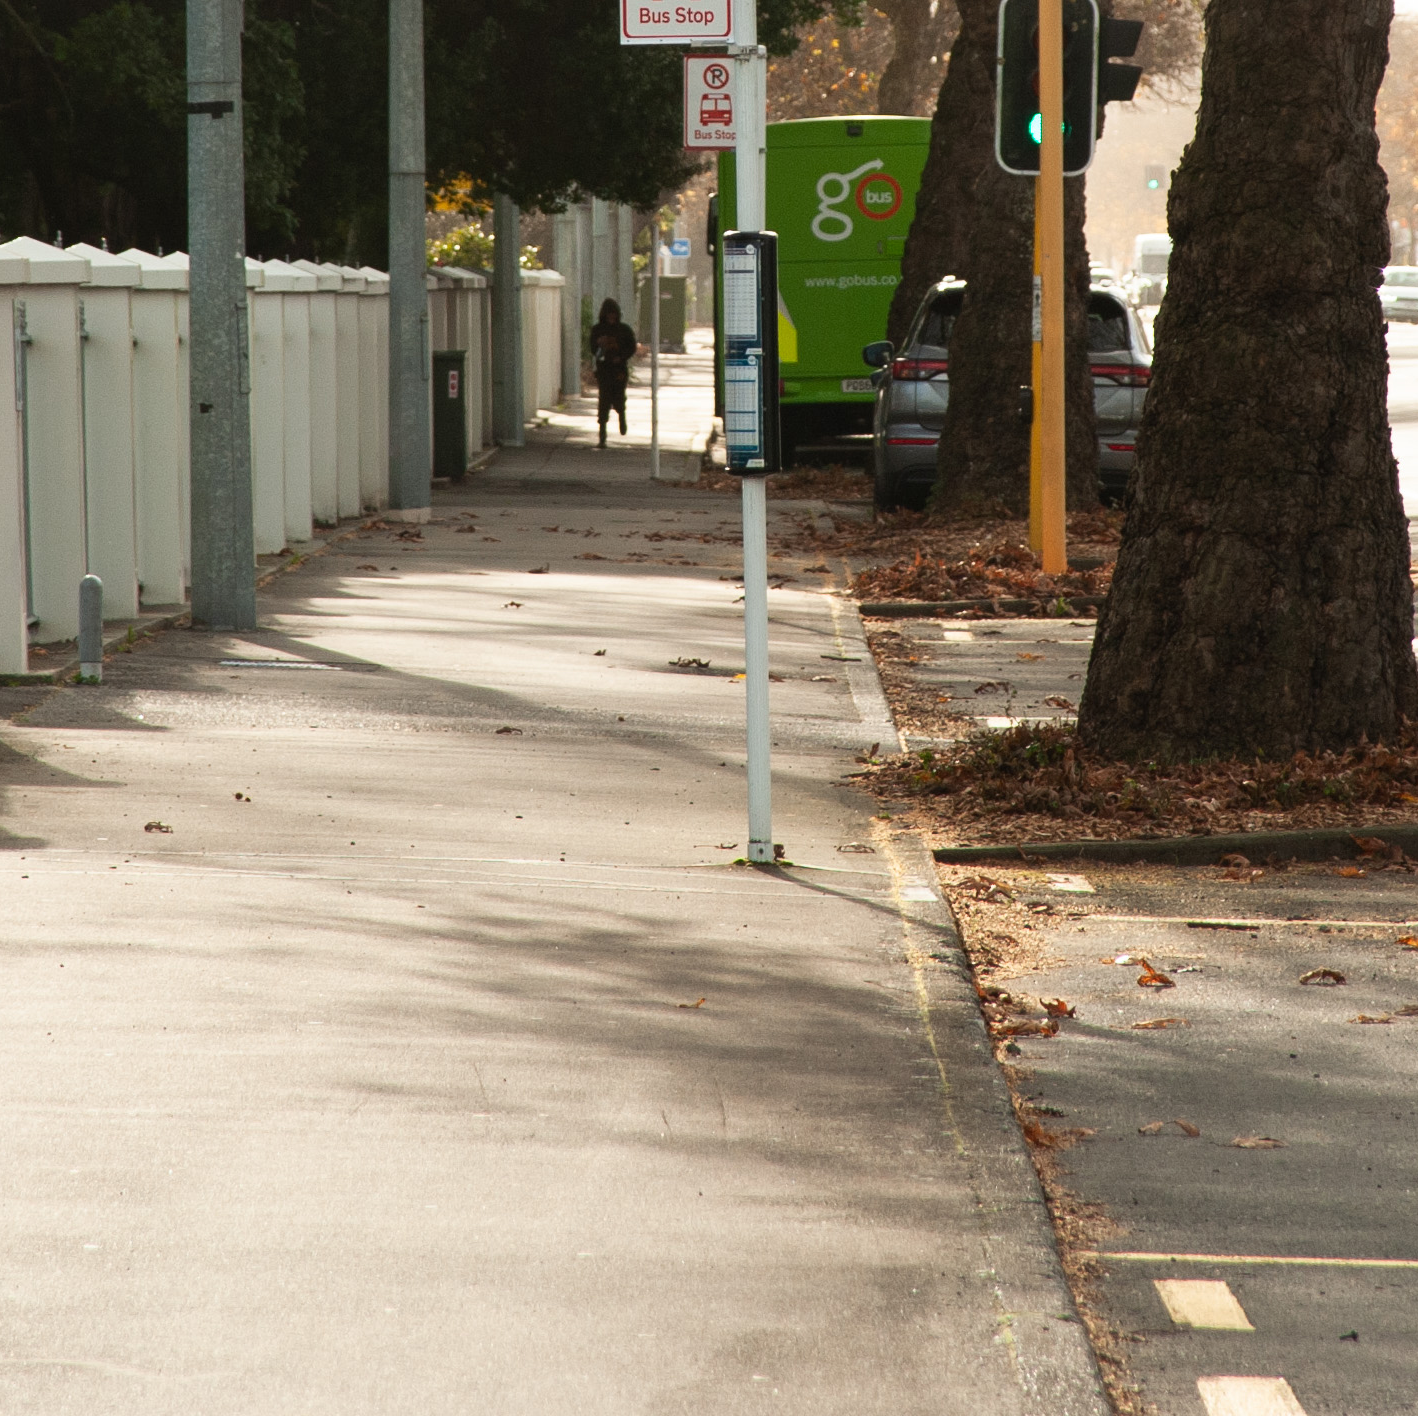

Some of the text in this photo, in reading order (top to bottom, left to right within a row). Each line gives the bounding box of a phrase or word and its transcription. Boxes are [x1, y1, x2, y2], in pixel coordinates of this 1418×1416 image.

[639, 6, 715, 26] Bus Stop
[694, 129, 712, 140] Bus
[866, 189, 892, 204] bus
